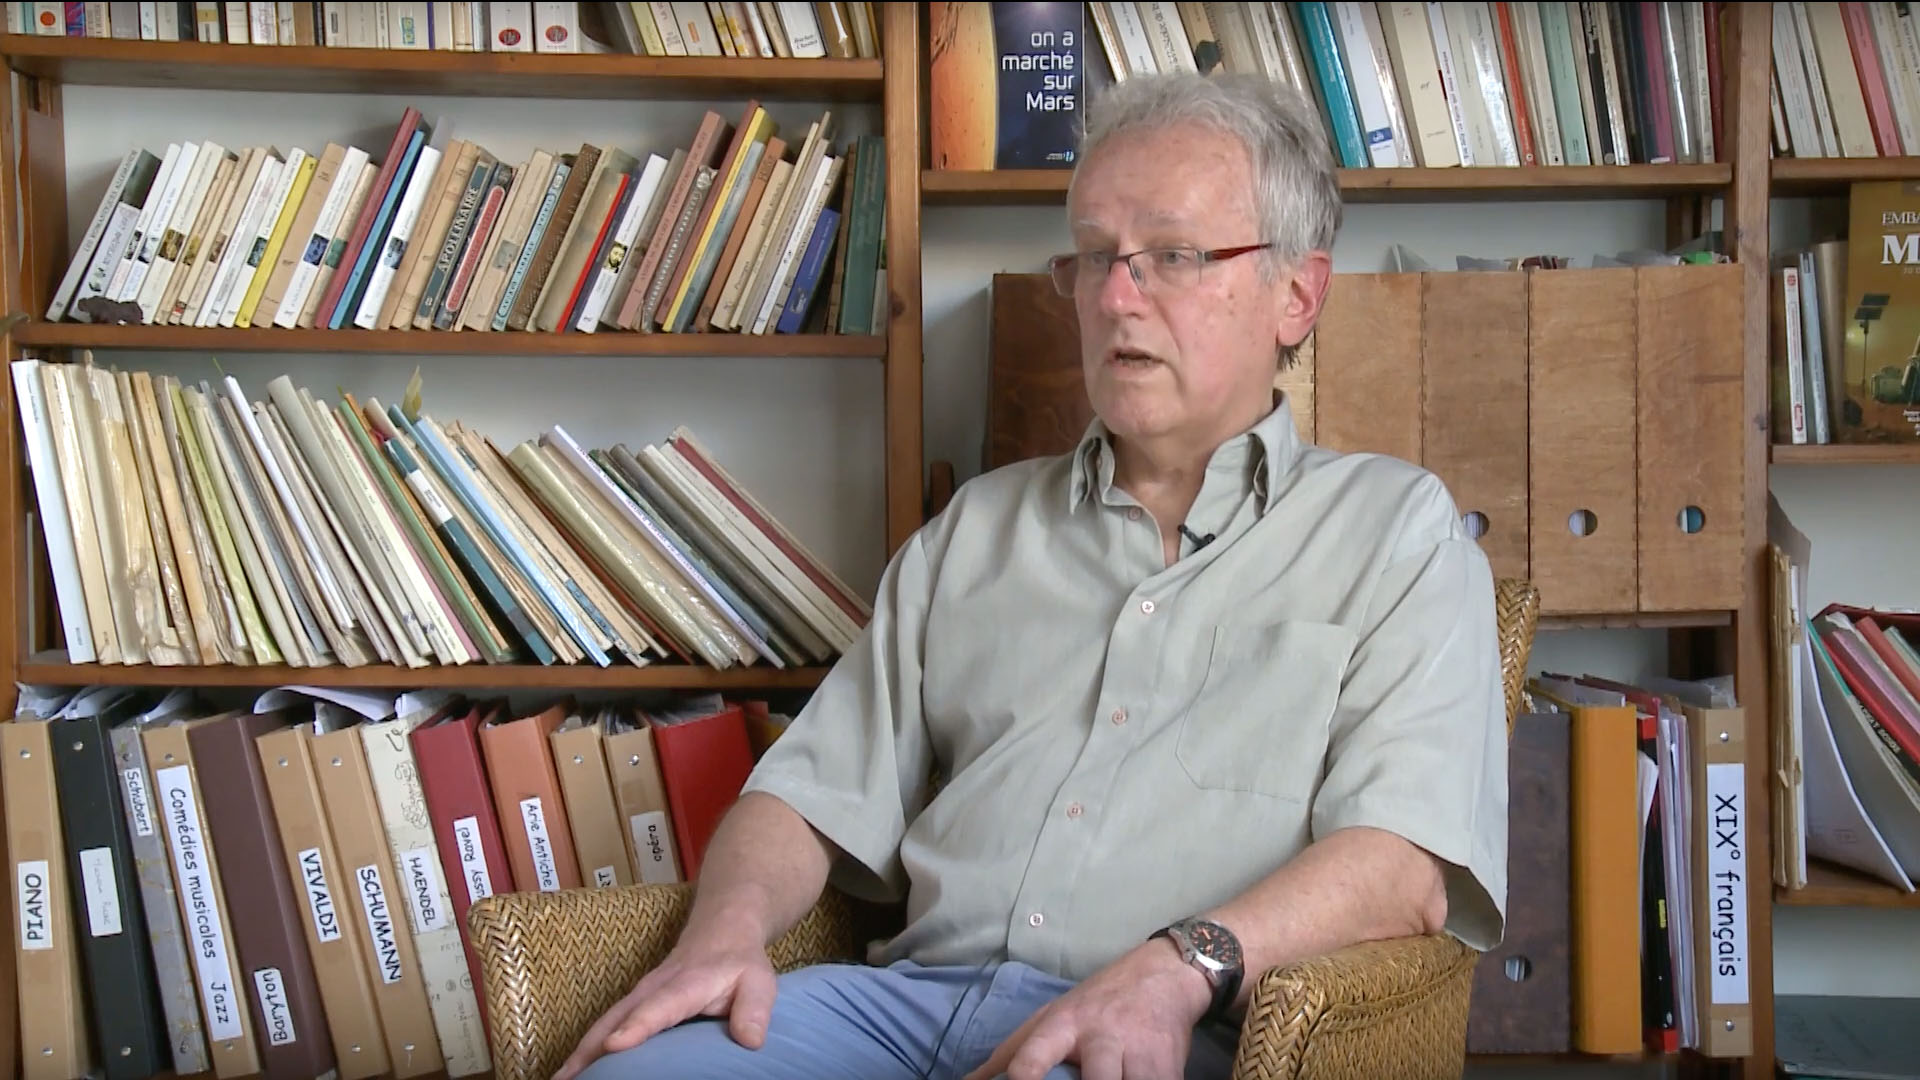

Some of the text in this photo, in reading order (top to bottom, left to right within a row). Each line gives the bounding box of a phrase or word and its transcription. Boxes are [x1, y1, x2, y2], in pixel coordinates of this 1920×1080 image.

[1002, 51, 1074, 71] marché
[1031, 31, 1074, 47] on a
[1026, 92, 1074, 112] Mars
[1043, 75, 1074, 90] sur
[126, 770, 150, 833] Schubert
[456, 827, 476, 862] Ravel
[527, 803, 552, 888] Arie Antiche
[648, 824, 662, 863] opéra
[26, 873, 44, 941] PIANO
[169, 786, 229, 1024] Comédies musicales Jazz
[303, 852, 338, 937] VIVALDI
[359, 868, 402, 981] SCHUMANN
[408, 857, 438, 925] HAENDEL
[1711, 869, 1742, 977] français
[262, 972, 288, 1042] Baryton
